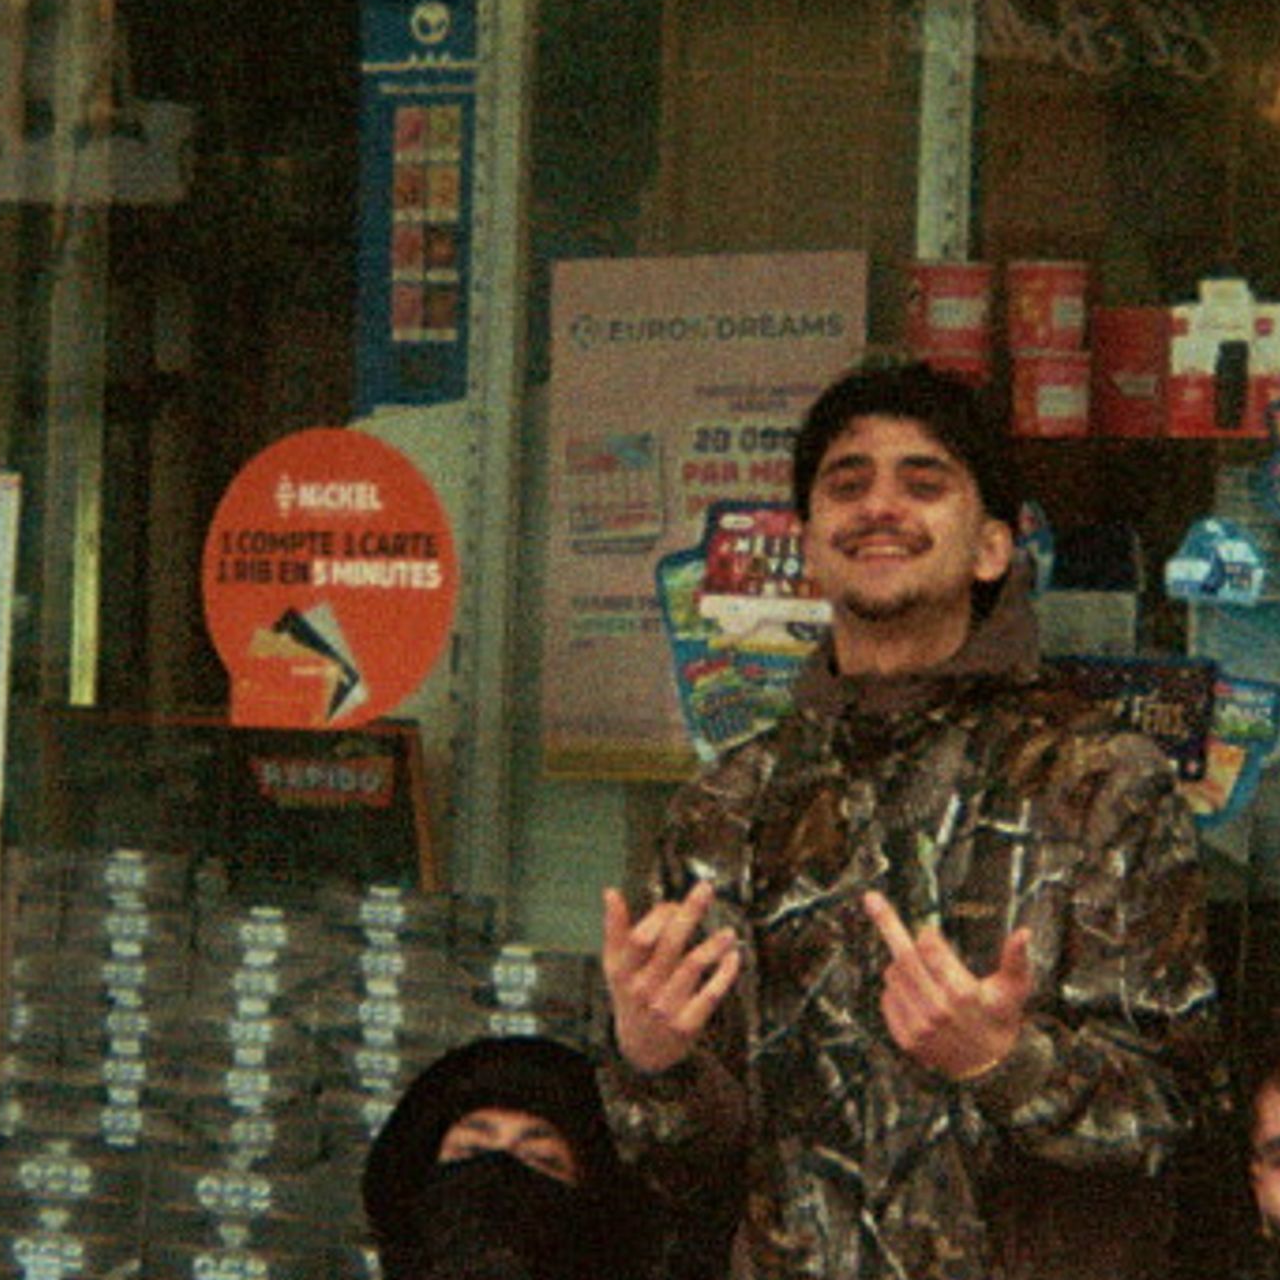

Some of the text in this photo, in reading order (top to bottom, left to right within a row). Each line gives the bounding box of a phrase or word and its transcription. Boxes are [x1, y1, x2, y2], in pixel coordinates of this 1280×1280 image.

[716, 310, 844, 340] DREAMS
[235, 531, 333, 556] COMPTE
[360, 532, 439, 558] CARTE
[331, 560, 443, 589] MINUTES
